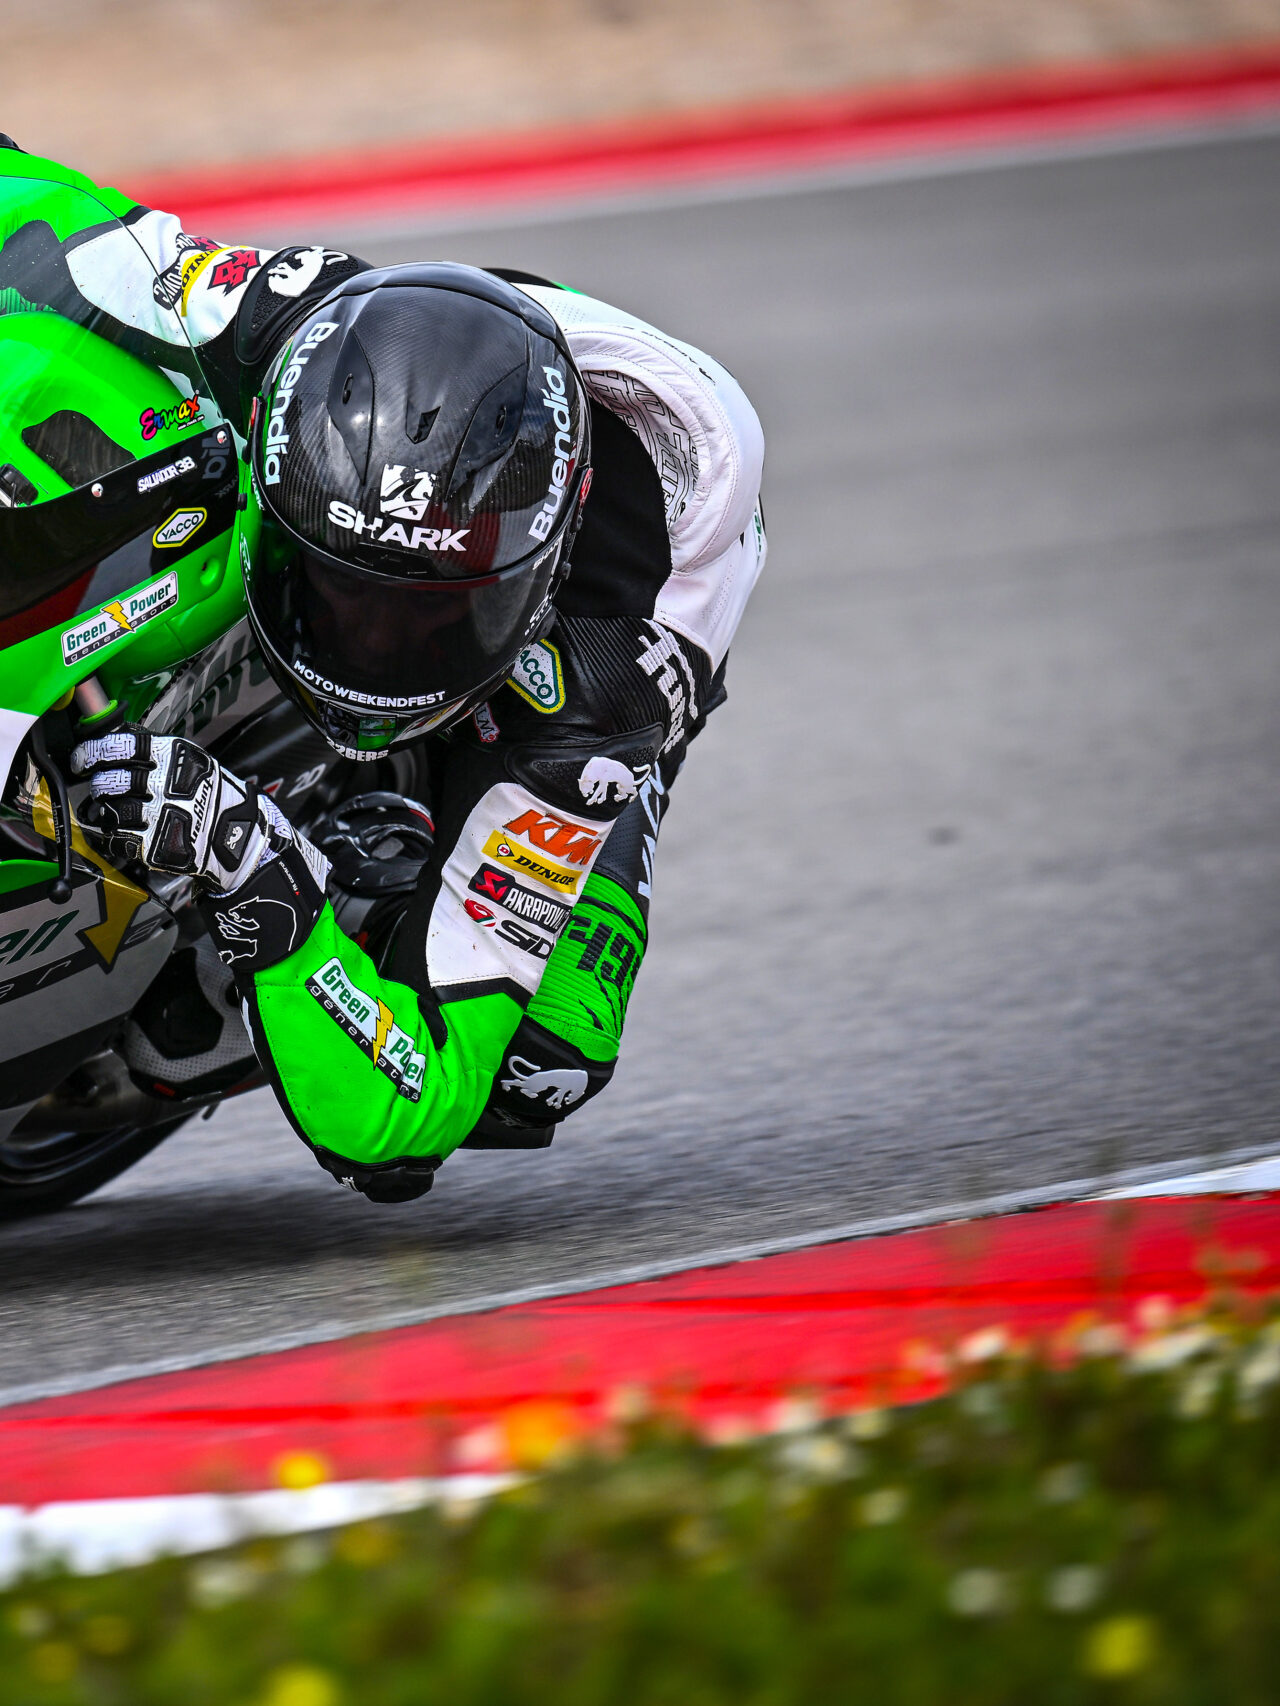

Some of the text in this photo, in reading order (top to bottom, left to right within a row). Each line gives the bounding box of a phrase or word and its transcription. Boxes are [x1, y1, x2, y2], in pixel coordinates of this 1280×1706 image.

[140, 394, 200, 440] Ermax
[161, 514, 200, 541] YACCO
[327, 500, 472, 552] SHARK
[66, 582, 172, 652] Green Power
[293, 660, 446, 708] MOTOWEEKENDFEST
[519, 649, 554, 700] ACCO
[502, 808, 603, 866] KTM
[513, 855, 575, 886] DUNLOP
[321, 964, 371, 1024] Green
